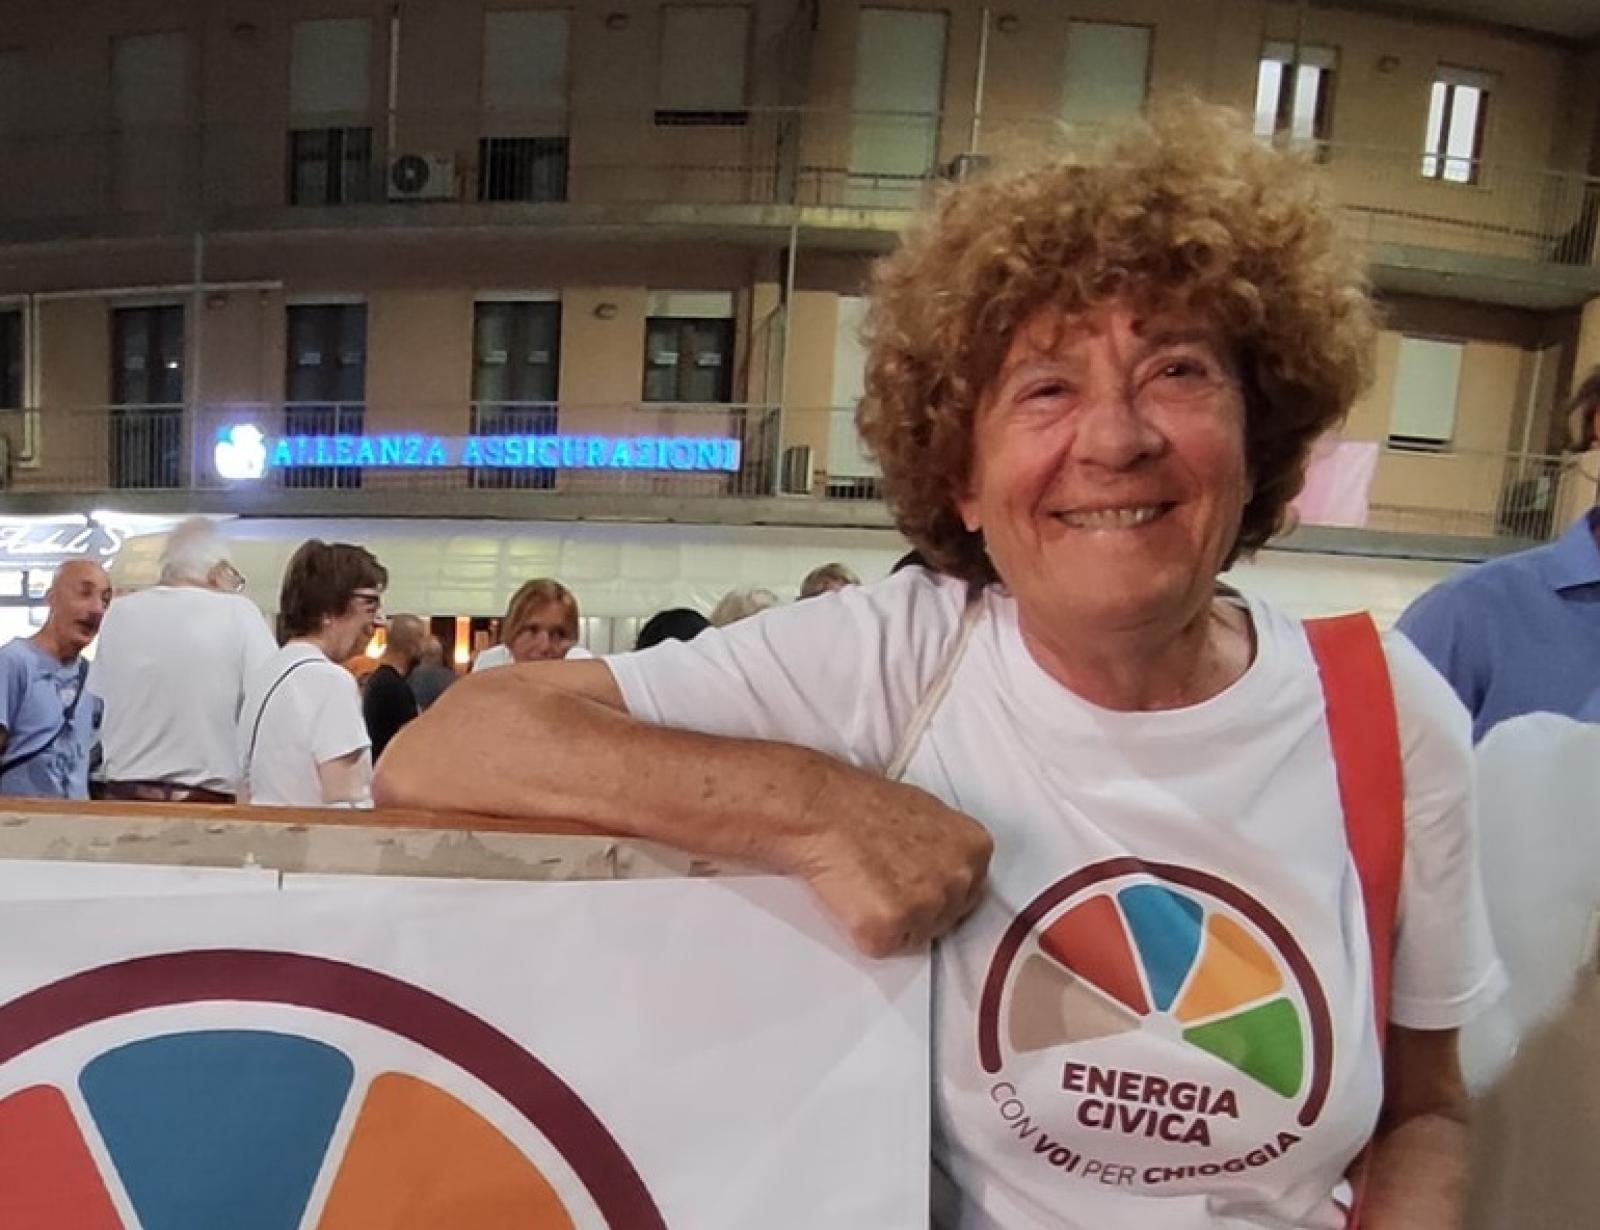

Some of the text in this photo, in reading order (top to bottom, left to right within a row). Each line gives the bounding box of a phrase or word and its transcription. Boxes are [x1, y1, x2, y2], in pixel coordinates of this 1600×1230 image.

[272, 436, 737, 470] ALLEANZA ASSICURAZIONI
[1062, 1061, 1239, 1119] ENERGIA
[990, 1081, 1302, 1186] CON VOI PER CHIOGGIA
[1077, 1099, 1211, 1147] CIVICA
